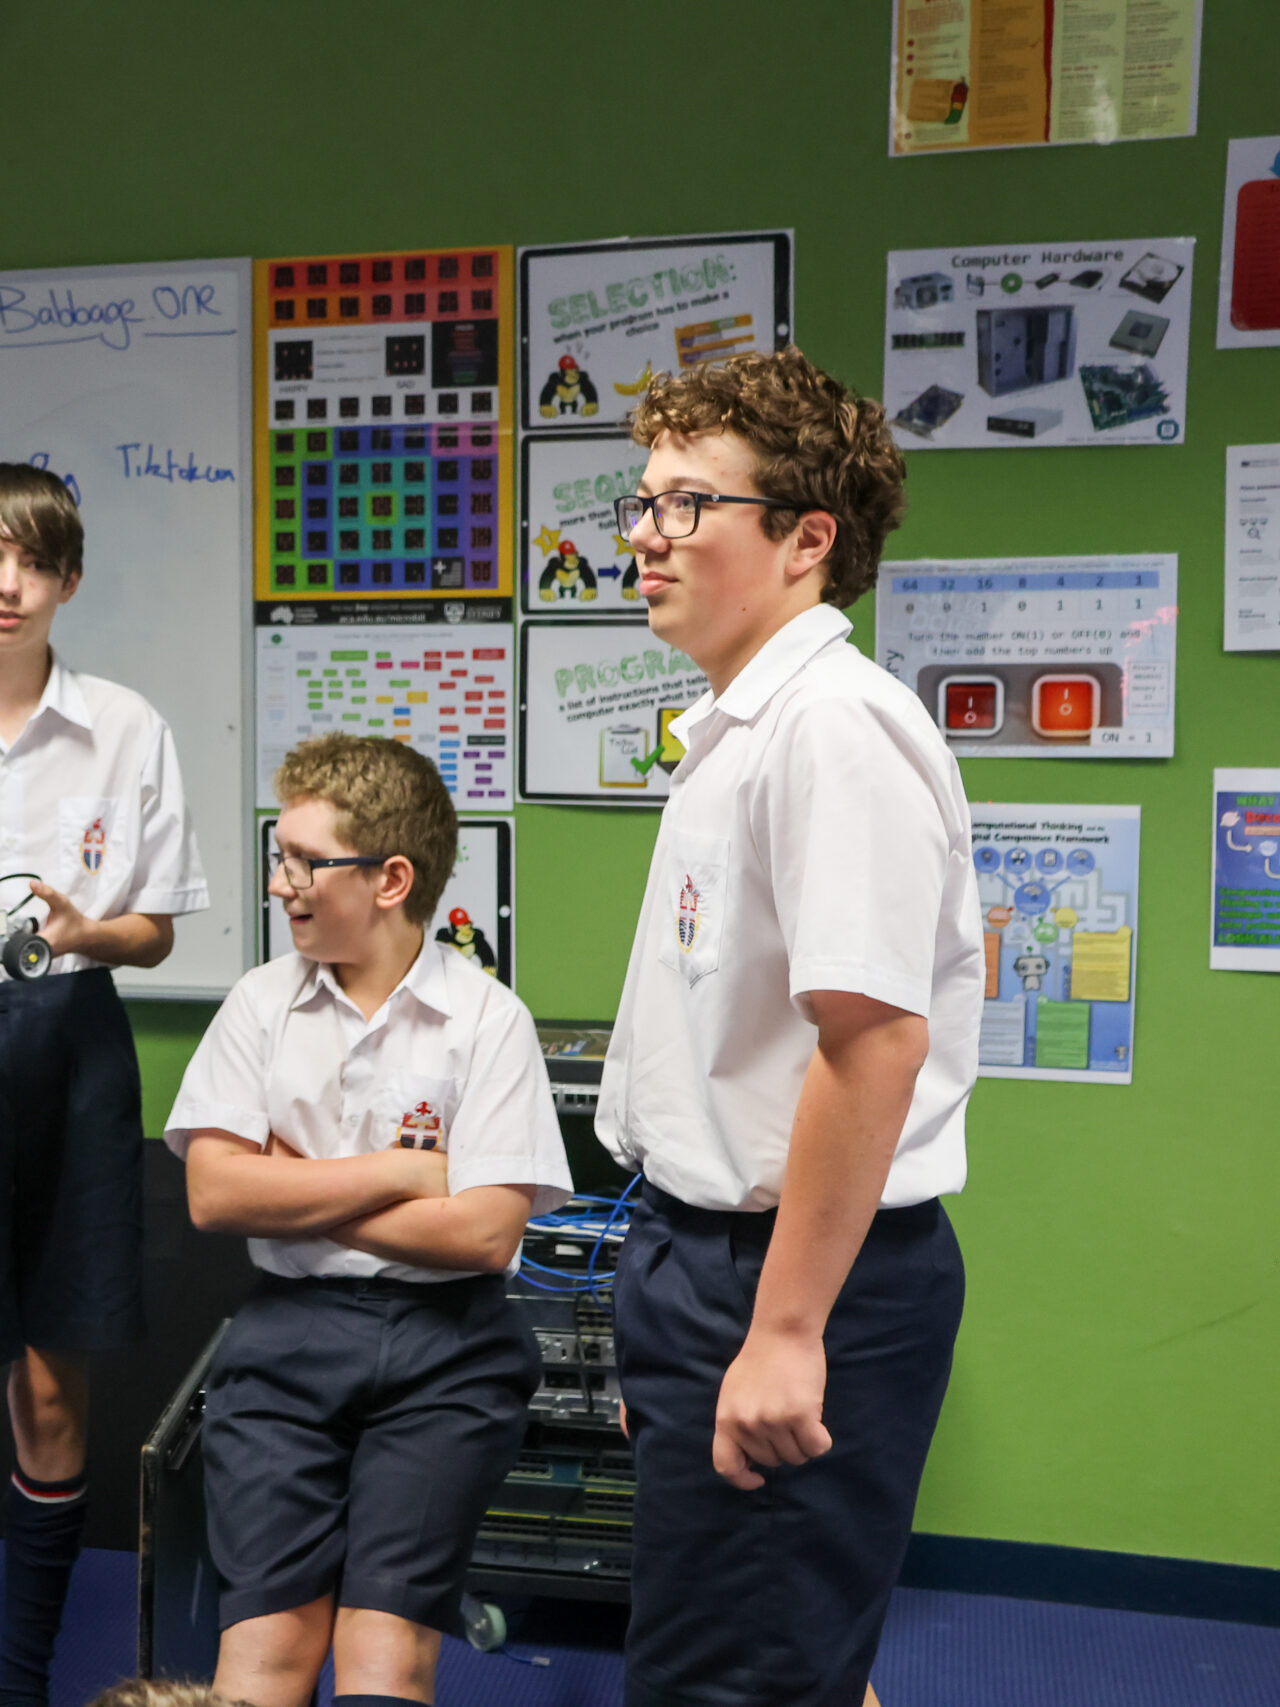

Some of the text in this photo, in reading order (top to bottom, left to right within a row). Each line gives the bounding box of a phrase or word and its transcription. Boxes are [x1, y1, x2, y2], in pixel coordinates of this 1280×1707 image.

[952, 248, 1124, 270] Computer Hardware
[584, 323, 606, 338] your
[610, 311, 654, 330] program
[553, 464, 647, 513] SEQU
[902, 580, 918, 592] 64
[978, 577, 992, 590] 16
[1056, 575, 1065, 587] 4
[1096, 575, 1104, 587] 2
[1135, 574, 1142, 586] 1
[1045, 646, 1091, 656] numbers
[554, 648, 700, 698] PROGRA
[586, 695, 597, 707] of
[600, 685, 659, 703] instructions
[567, 706, 615, 723] computer
[618, 698, 655, 713] exactly
[1102, 732, 1119, 743] ON
